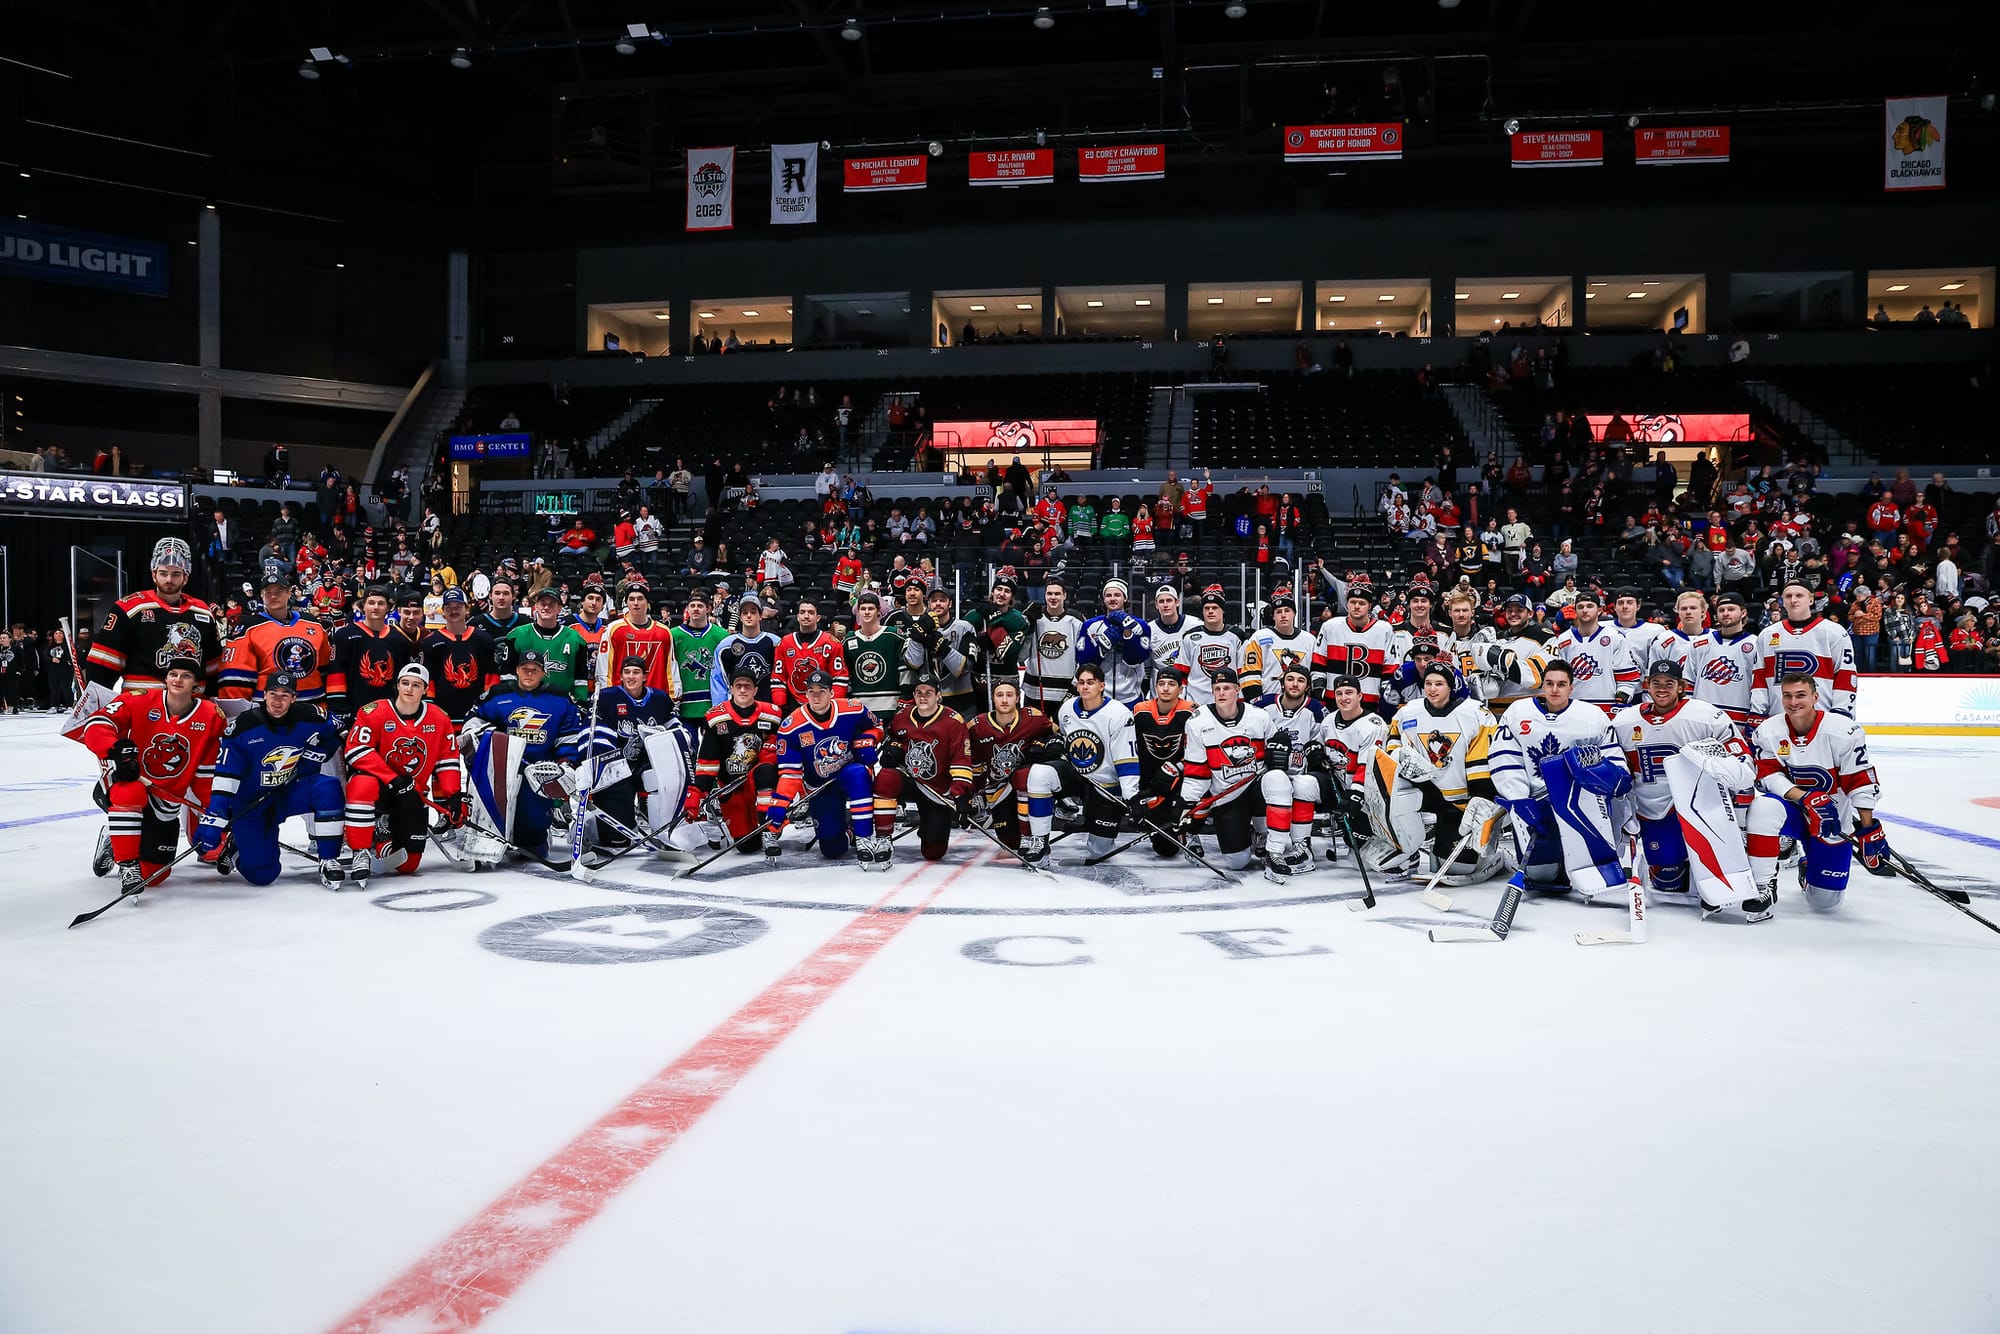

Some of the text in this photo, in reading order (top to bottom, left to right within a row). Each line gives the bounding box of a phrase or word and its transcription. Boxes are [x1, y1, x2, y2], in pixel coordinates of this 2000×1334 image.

[1309, 127, 1377, 138] ROCKFORD ICEHOGS
[1666, 130, 1688, 139] BRYAN
[1690, 129, 1720, 138] BICKELL
[1318, 138, 1371, 149] RING OF HONOR
[1522, 133, 1591, 144] STEVE MARTINSON
[987, 152, 1036, 162] 53 J.F. RIVARD
[1095, 149, 1118, 158] COREY
[1119, 147, 1158, 157] CRAWFORD
[861, 160, 888, 169] MICHAEL
[889, 158, 920, 167] LEIGHTON
[1900, 160, 1931, 168] CHICAGO
[693, 172, 727, 182] ALL STAR
[1891, 167, 1942, 178] BLACKHAWKS
[775, 196, 811, 205] SCREW CITY
[695, 204, 722, 217] 2026
[780, 204, 805, 212] ICEHOGS
[49, 243, 152, 277] LIGHT
[454, 443, 474, 451] BMO
[976, 487, 989, 495] 103
[1308, 484, 1322, 492] 104
[93, 489, 184, 508] CLASSI
[535, 494, 578, 513] MILIC
[562, 643, 571, 656] A
[822, 643, 832, 659] C
[862, 653, 878, 661] IOWA
[1202, 651, 1227, 662] COMETS
[1344, 643, 1371, 680] B
[1842, 648, 1853, 665] 5
[774, 661, 783, 674] 2
[833, 656, 843, 671] 6
[106, 701, 123, 715] 4
[1068, 731, 1100, 745] CLEVELAND
[1641, 749, 1650, 782] ROCKET
[1717, 782, 1735, 823] BAUER
[1634, 892, 1643, 922] VAPOR
